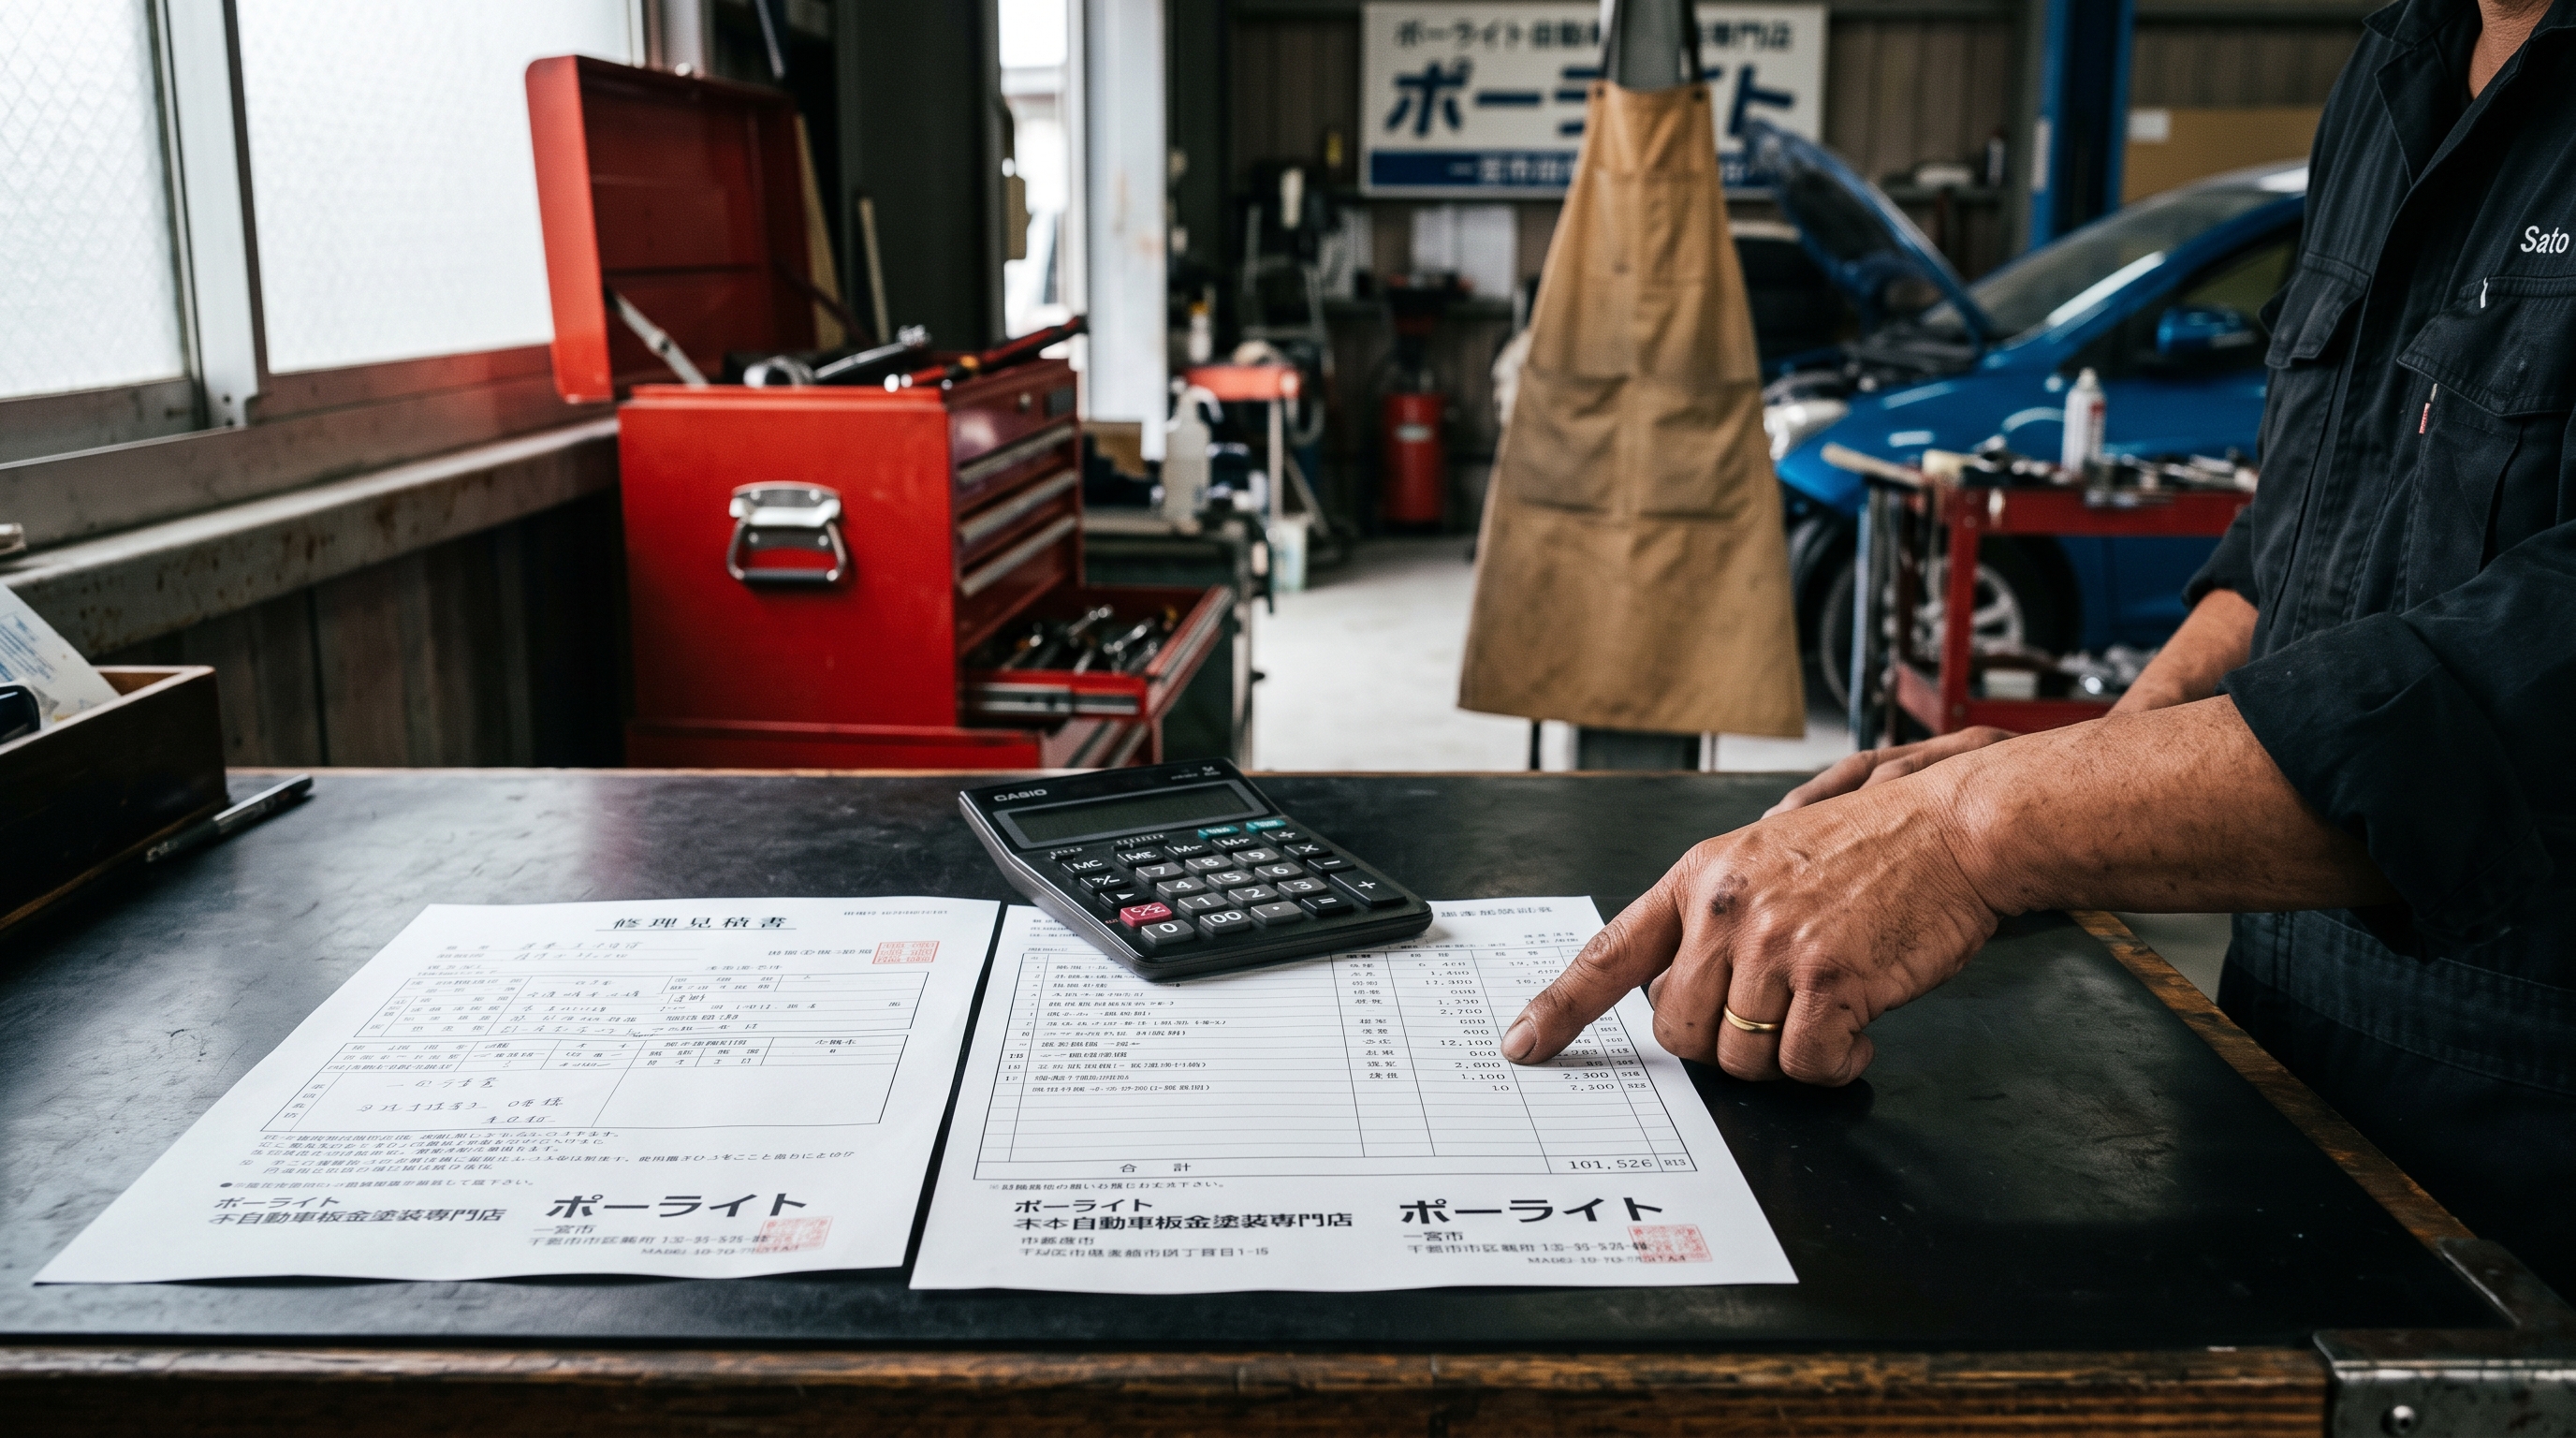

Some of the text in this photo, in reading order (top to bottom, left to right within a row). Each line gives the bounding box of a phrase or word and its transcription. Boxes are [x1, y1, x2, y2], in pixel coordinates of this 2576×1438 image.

[1386, 58, 1794, 137] ポート
[2520, 225, 2570, 254] Sato
[1072, 859, 1103, 870] MC
[1150, 866, 1165, 874] 7
[1200, 858, 1219, 867] 8
[1248, 851, 1266, 859] 9
[1176, 866, 1289, 889] 4 5 6
[1196, 896, 1212, 906] 1
[1245, 888, 1266, 899] 2
[1293, 881, 1312, 889] 3
[1159, 923, 1178, 933] 0
[1210, 911, 1242, 923] 00
[545, 1193, 808, 1218] ポーライト
[1399, 1197, 1663, 1225] ポーライト
